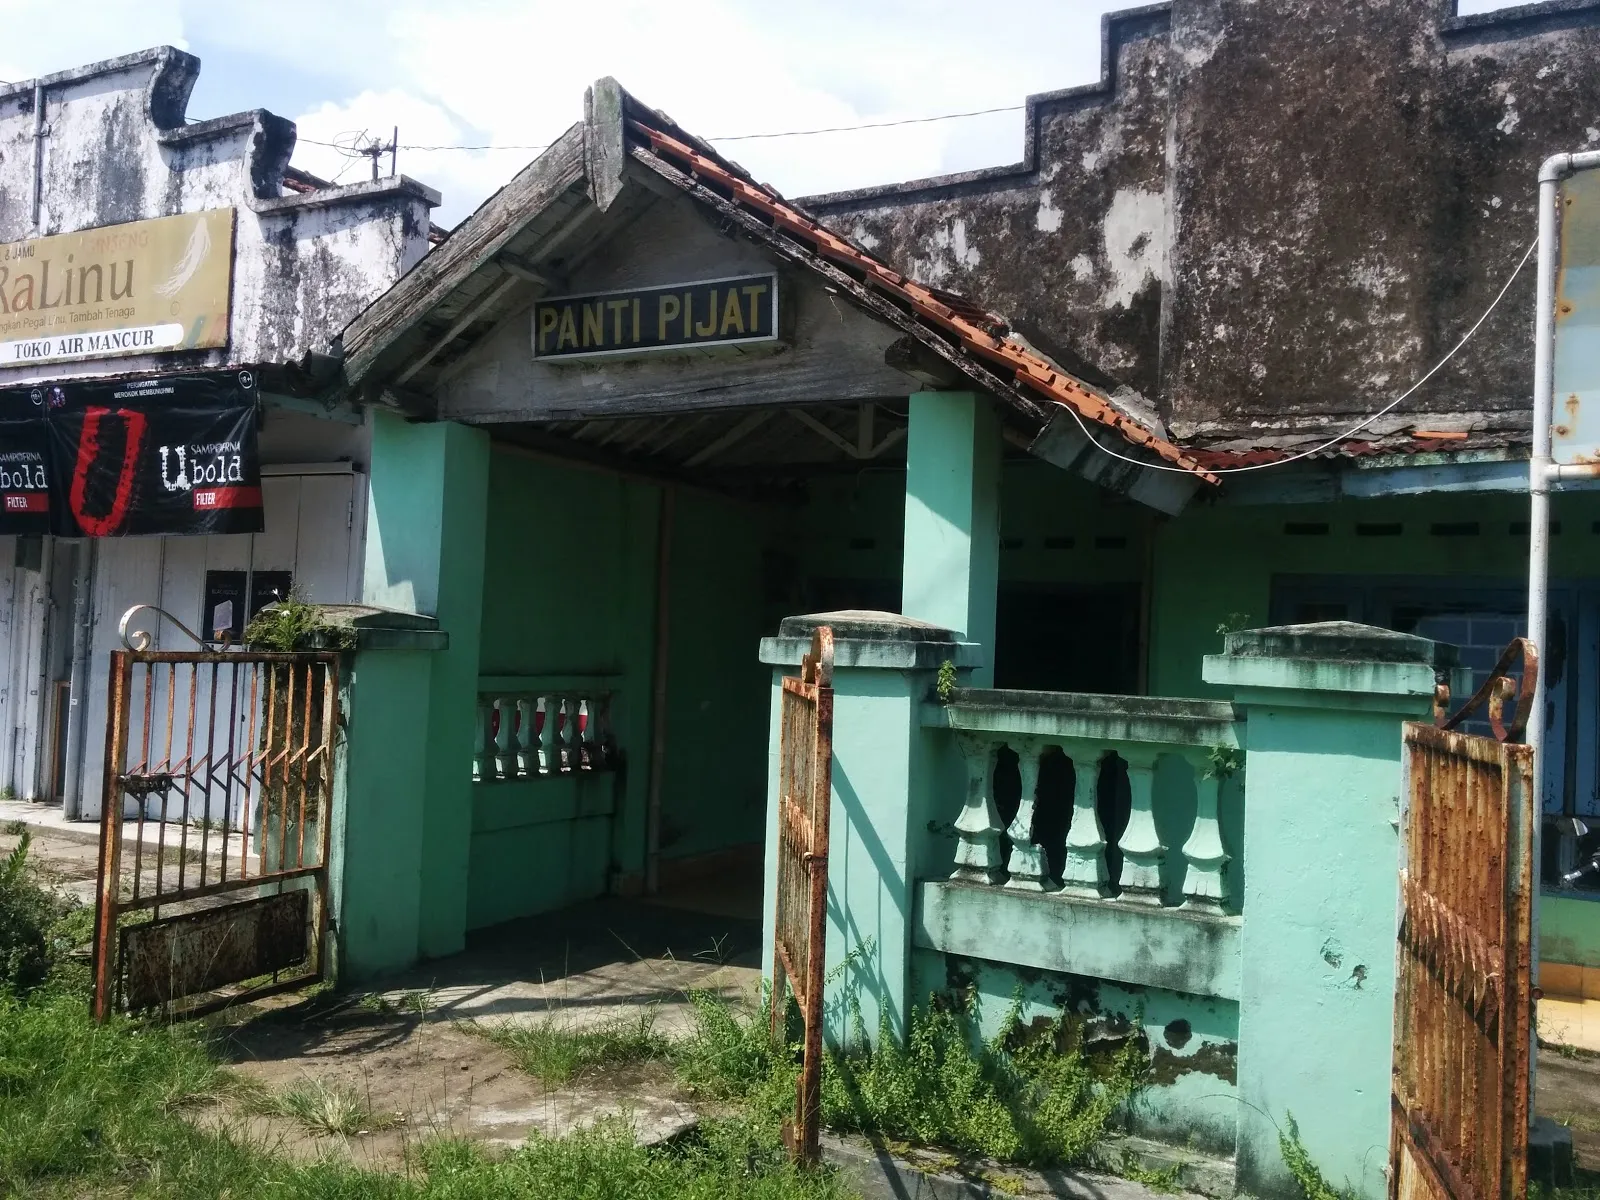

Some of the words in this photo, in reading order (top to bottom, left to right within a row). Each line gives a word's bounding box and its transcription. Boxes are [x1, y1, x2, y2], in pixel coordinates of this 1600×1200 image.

[23, 317, 46, 330] Pegal
[69, 309, 103, 323] Tambah
[105, 307, 136, 319] Tenaga
[538, 298, 641, 351] PANTI
[657, 284, 767, 341] PIJAT
[14, 341, 51, 359] TOKO
[57, 337, 84, 355] AIR
[87, 329, 154, 352] MANCUR
[191, 441, 241, 455] SAMPOERNA
[0, 464, 49, 489] bold
[190, 455, 245, 484] bold
[6, 496, 28, 508] FILTER
[196, 492, 216, 506] FILTER
